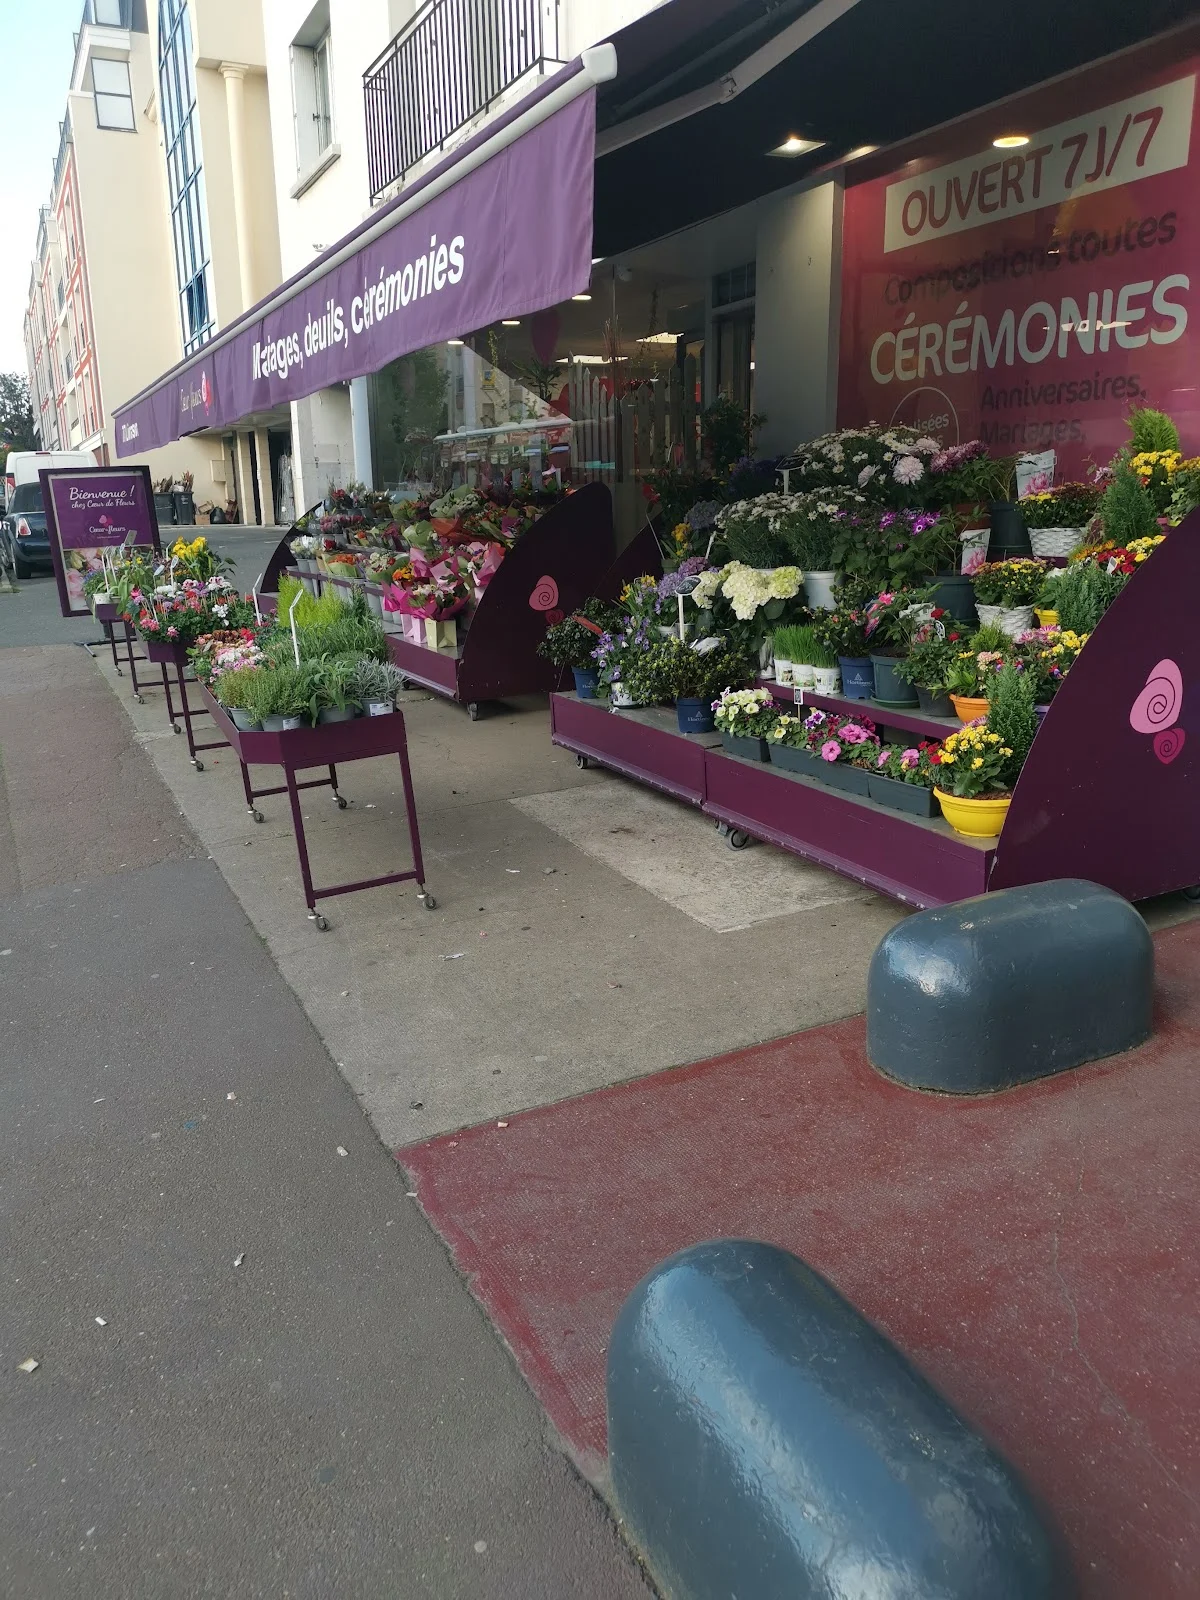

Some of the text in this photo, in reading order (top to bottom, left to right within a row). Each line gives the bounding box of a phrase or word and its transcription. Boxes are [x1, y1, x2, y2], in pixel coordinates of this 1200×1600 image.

[901, 106, 1164, 237] OUVERT 7J/7
[1066, 209, 1178, 266] toutes
[304, 297, 349, 357] deuils,
[351, 233, 465, 335] cérémonies
[870, 273, 1190, 385] CÉRÉMONIES
[69, 485, 135, 501] Bienvenue !
[71, 500, 86, 510] chez
